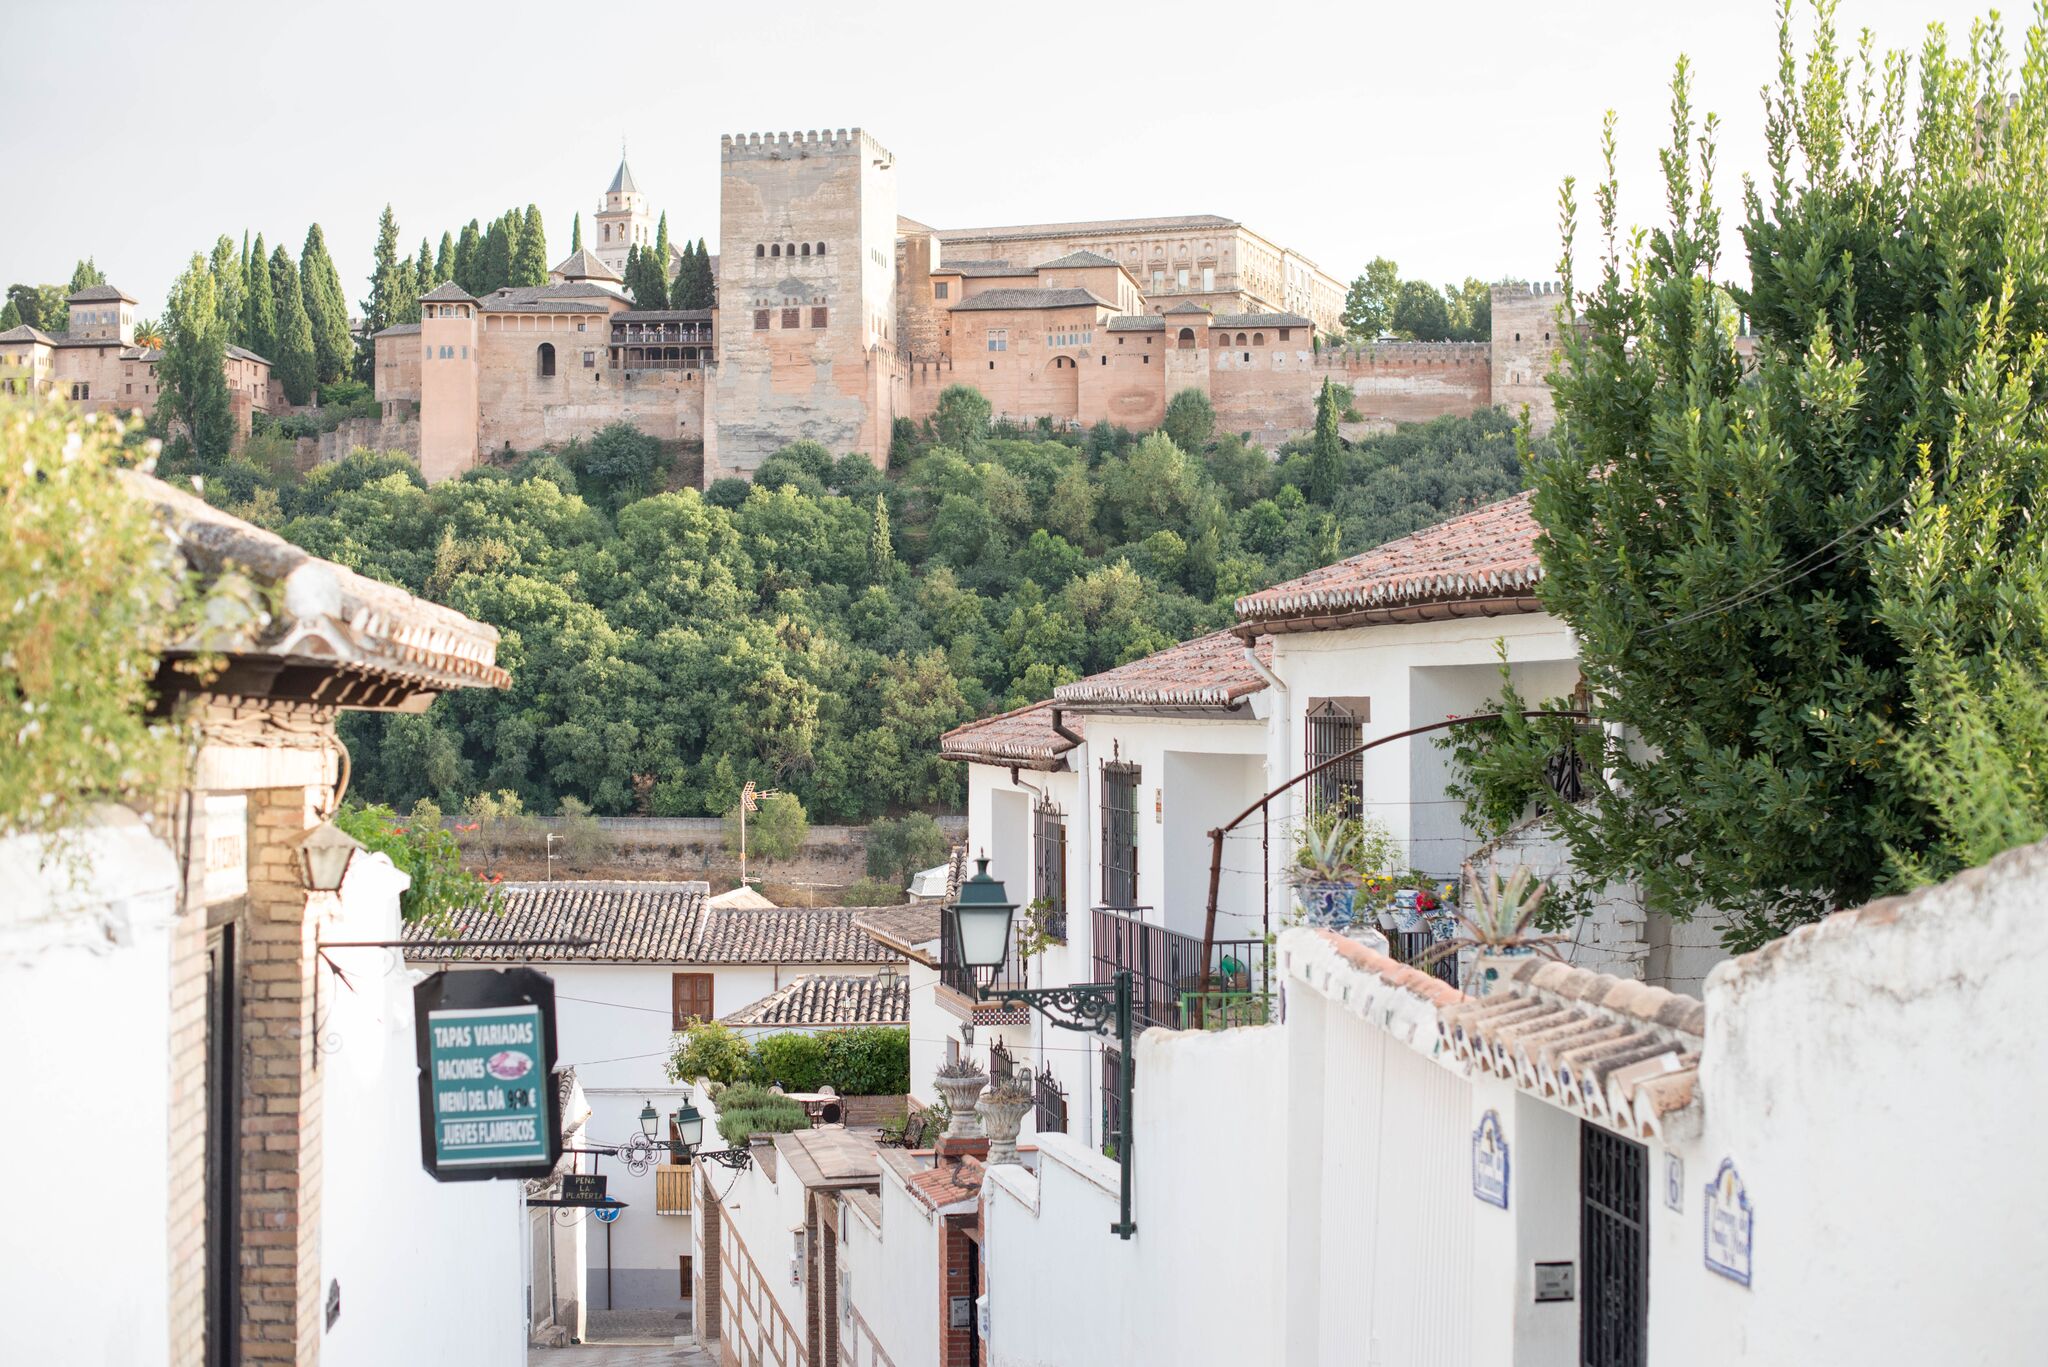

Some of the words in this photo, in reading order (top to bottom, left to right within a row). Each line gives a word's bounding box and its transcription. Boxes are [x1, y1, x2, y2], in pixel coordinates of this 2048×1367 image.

[434, 1026, 472, 1048] TAPAS
[474, 1022, 533, 1047] VARIADAS
[437, 1058, 485, 1081] RACIONES
[439, 1087, 467, 1113] MENÚ
[468, 1090, 487, 1111] DEL
[487, 1085, 505, 1110] DÍA
[441, 1123, 478, 1145] JUEVES
[478, 1119, 536, 1144] FLAMENCOS
[579, 1185, 590, 1193] LA
